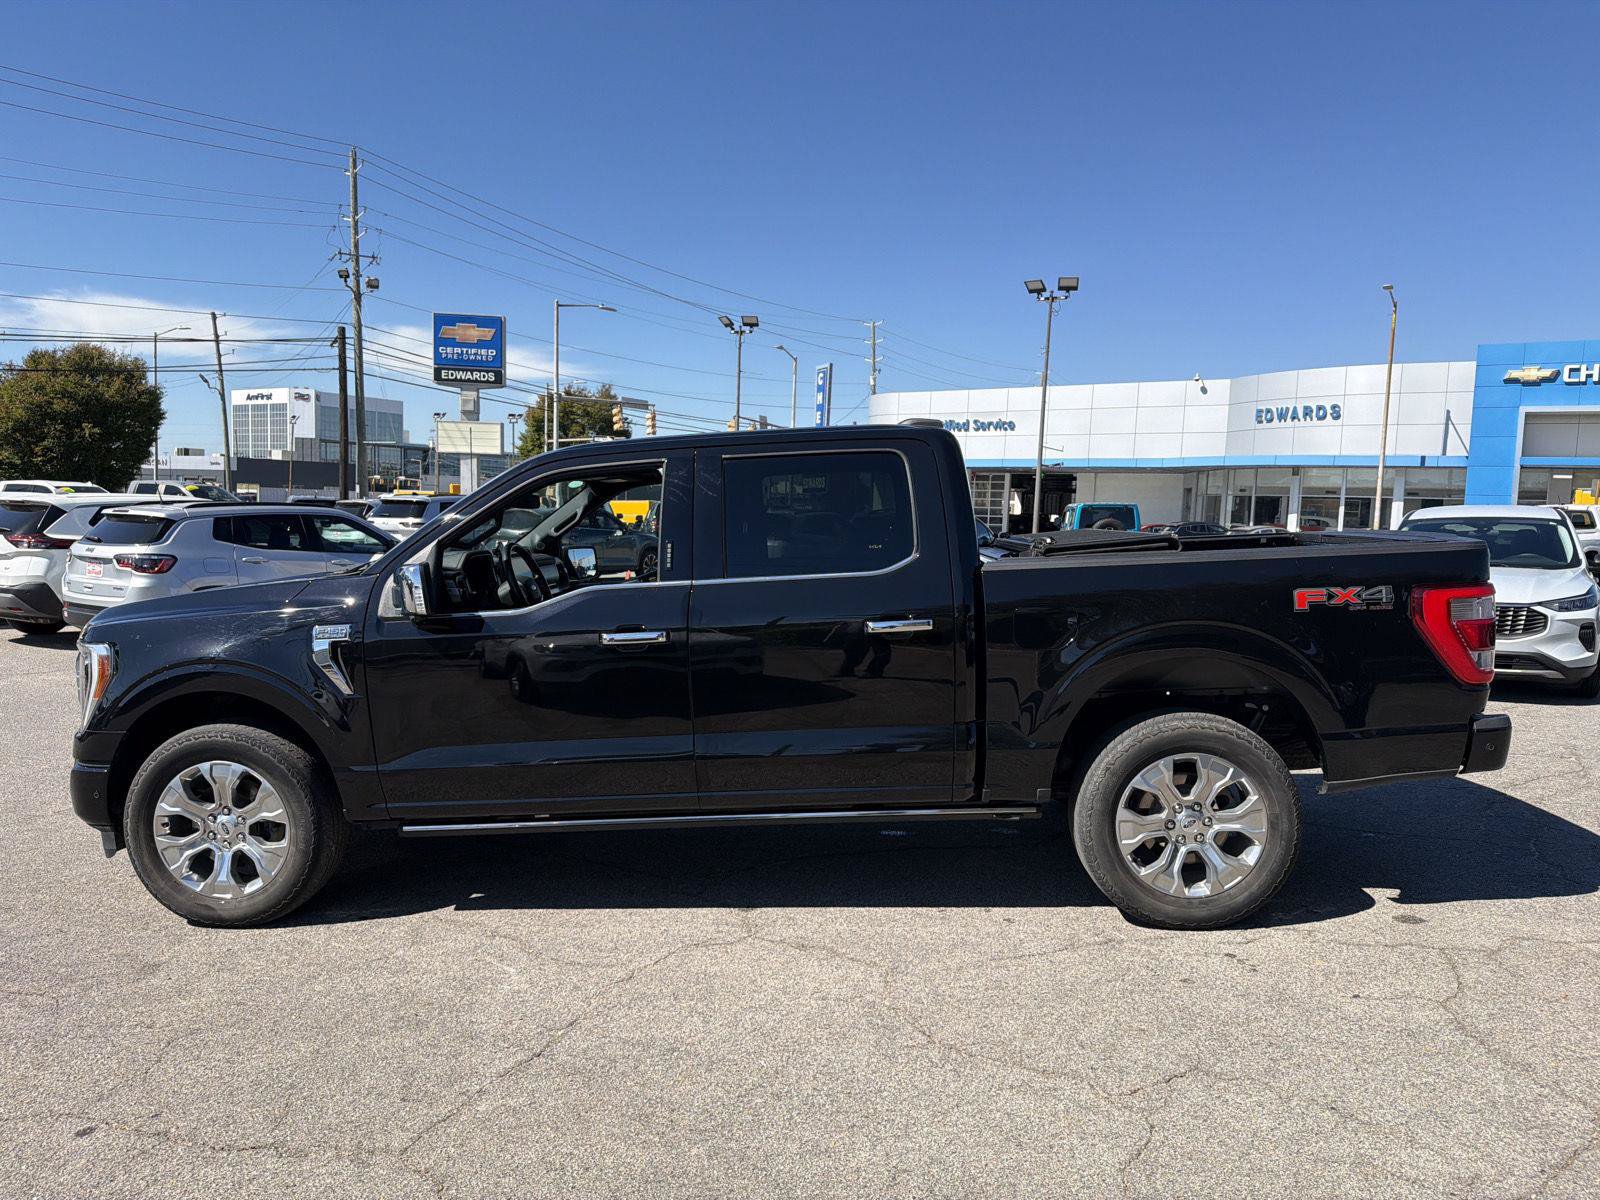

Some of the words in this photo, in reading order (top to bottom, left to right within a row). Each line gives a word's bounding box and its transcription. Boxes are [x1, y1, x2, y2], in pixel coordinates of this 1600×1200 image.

[439, 346, 497, 356] CERTIFIED
[441, 353, 494, 361] PRE-OWNED
[441, 369, 495, 381] EDWARDS
[245, 392, 273, 401] AmFirst
[1255, 403, 1342, 425] EDWARDS
[972, 418, 1016, 432] Service
[1293, 584, 1395, 612] FX4
